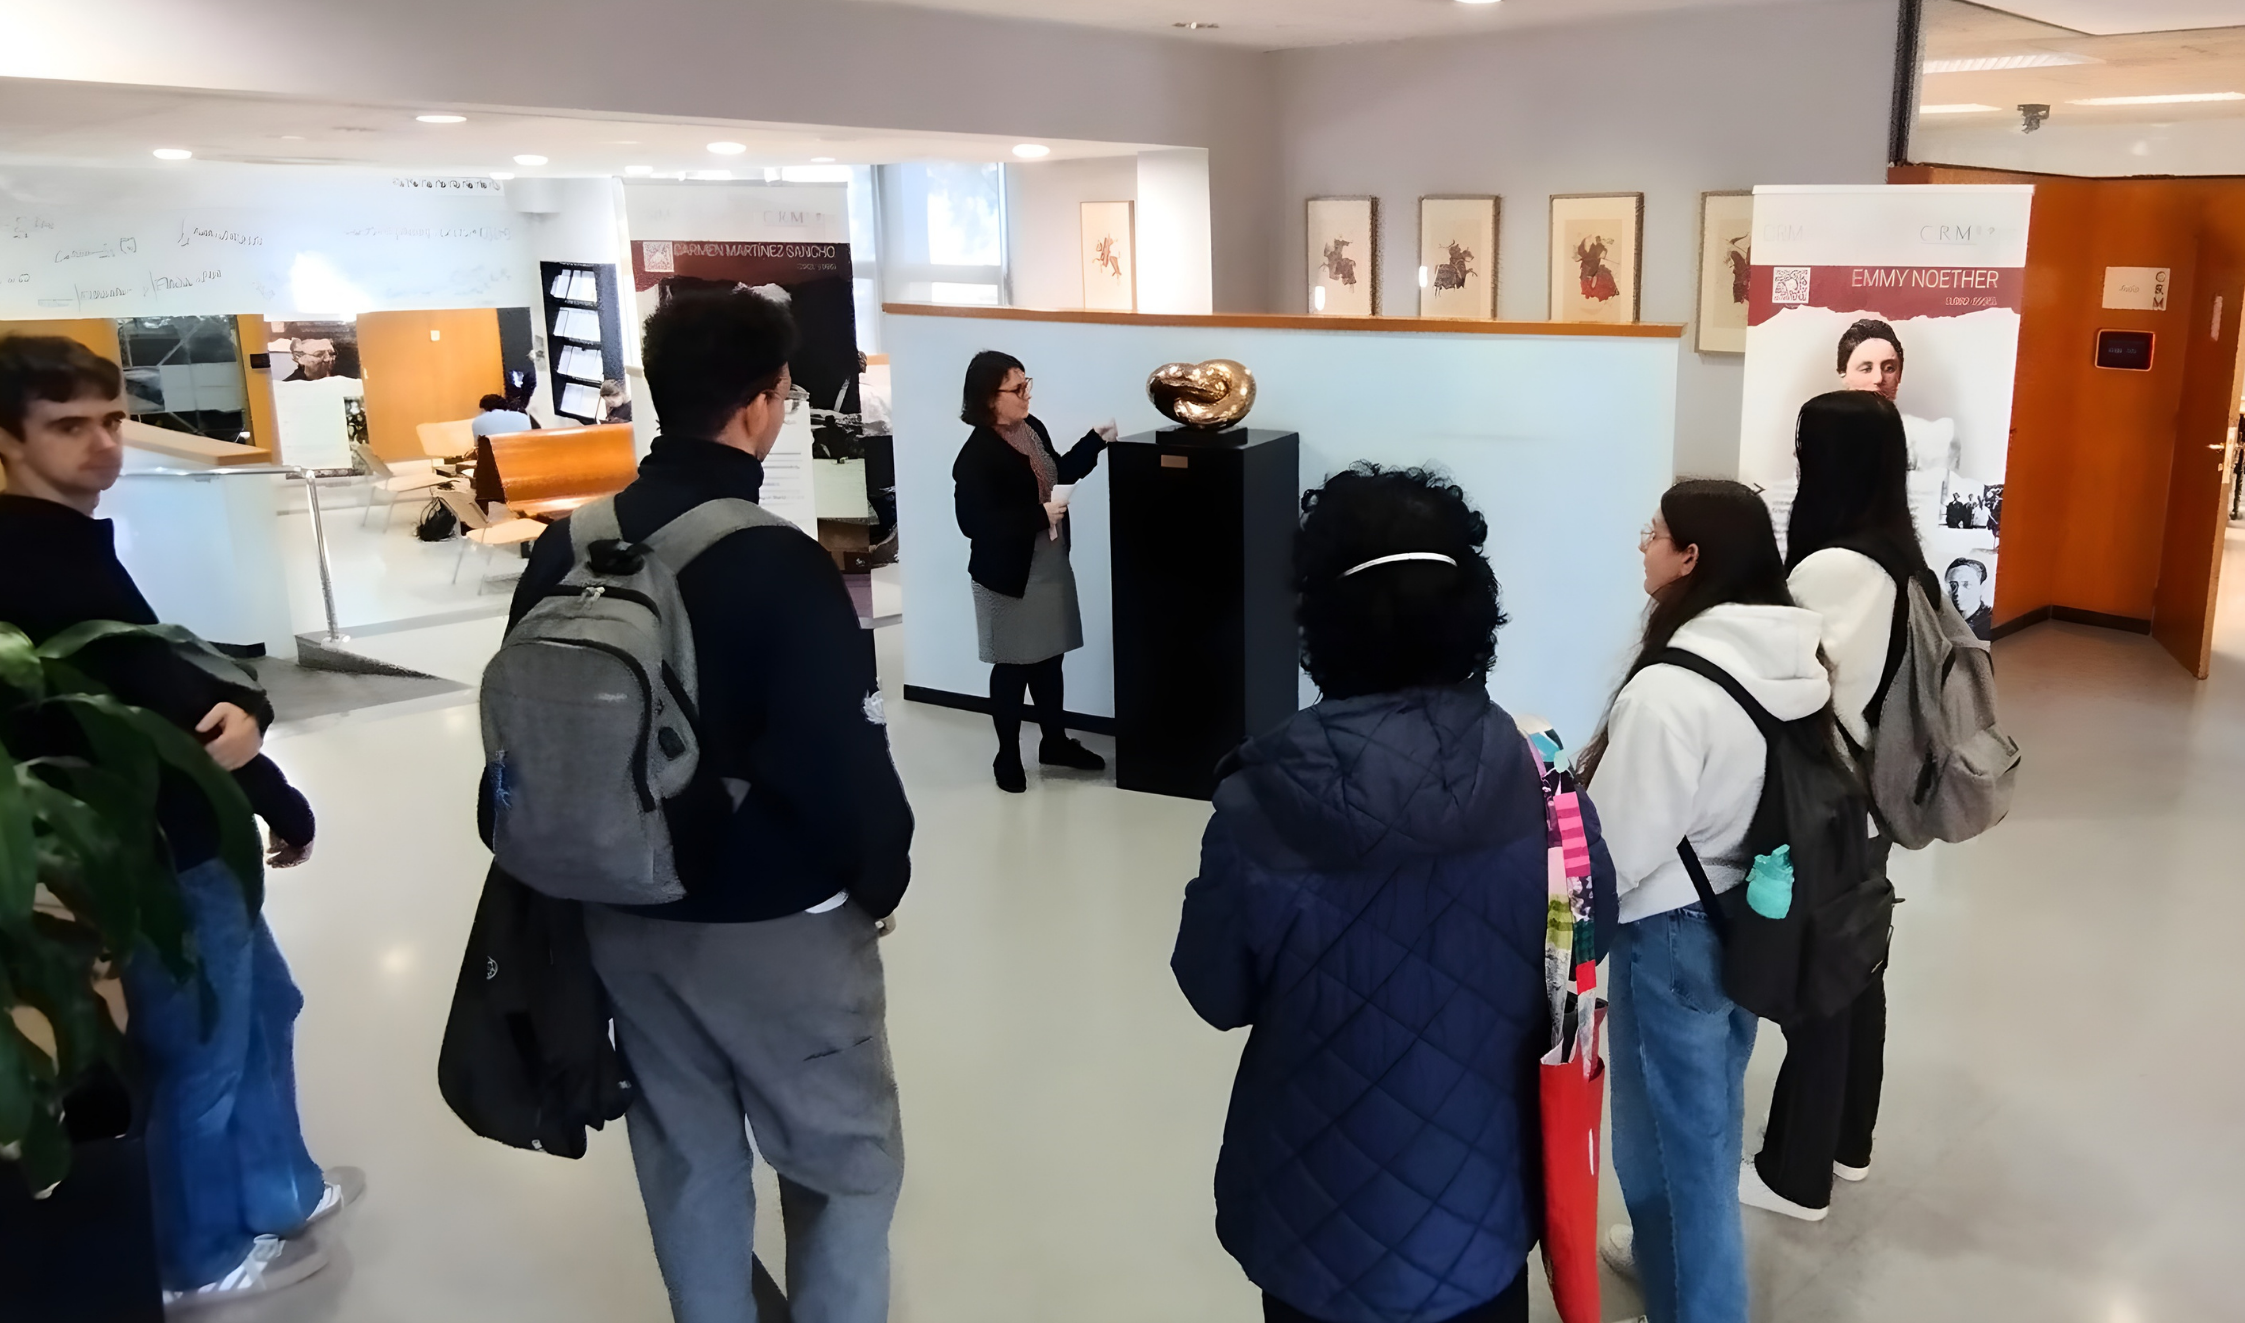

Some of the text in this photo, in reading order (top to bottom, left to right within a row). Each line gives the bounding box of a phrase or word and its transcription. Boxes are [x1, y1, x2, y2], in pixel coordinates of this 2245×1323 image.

[1920, 225, 1972, 241] CRM
[674, 243, 724, 256] CARMEN
[1852, 268, 1999, 289] EMMY NOETHER
